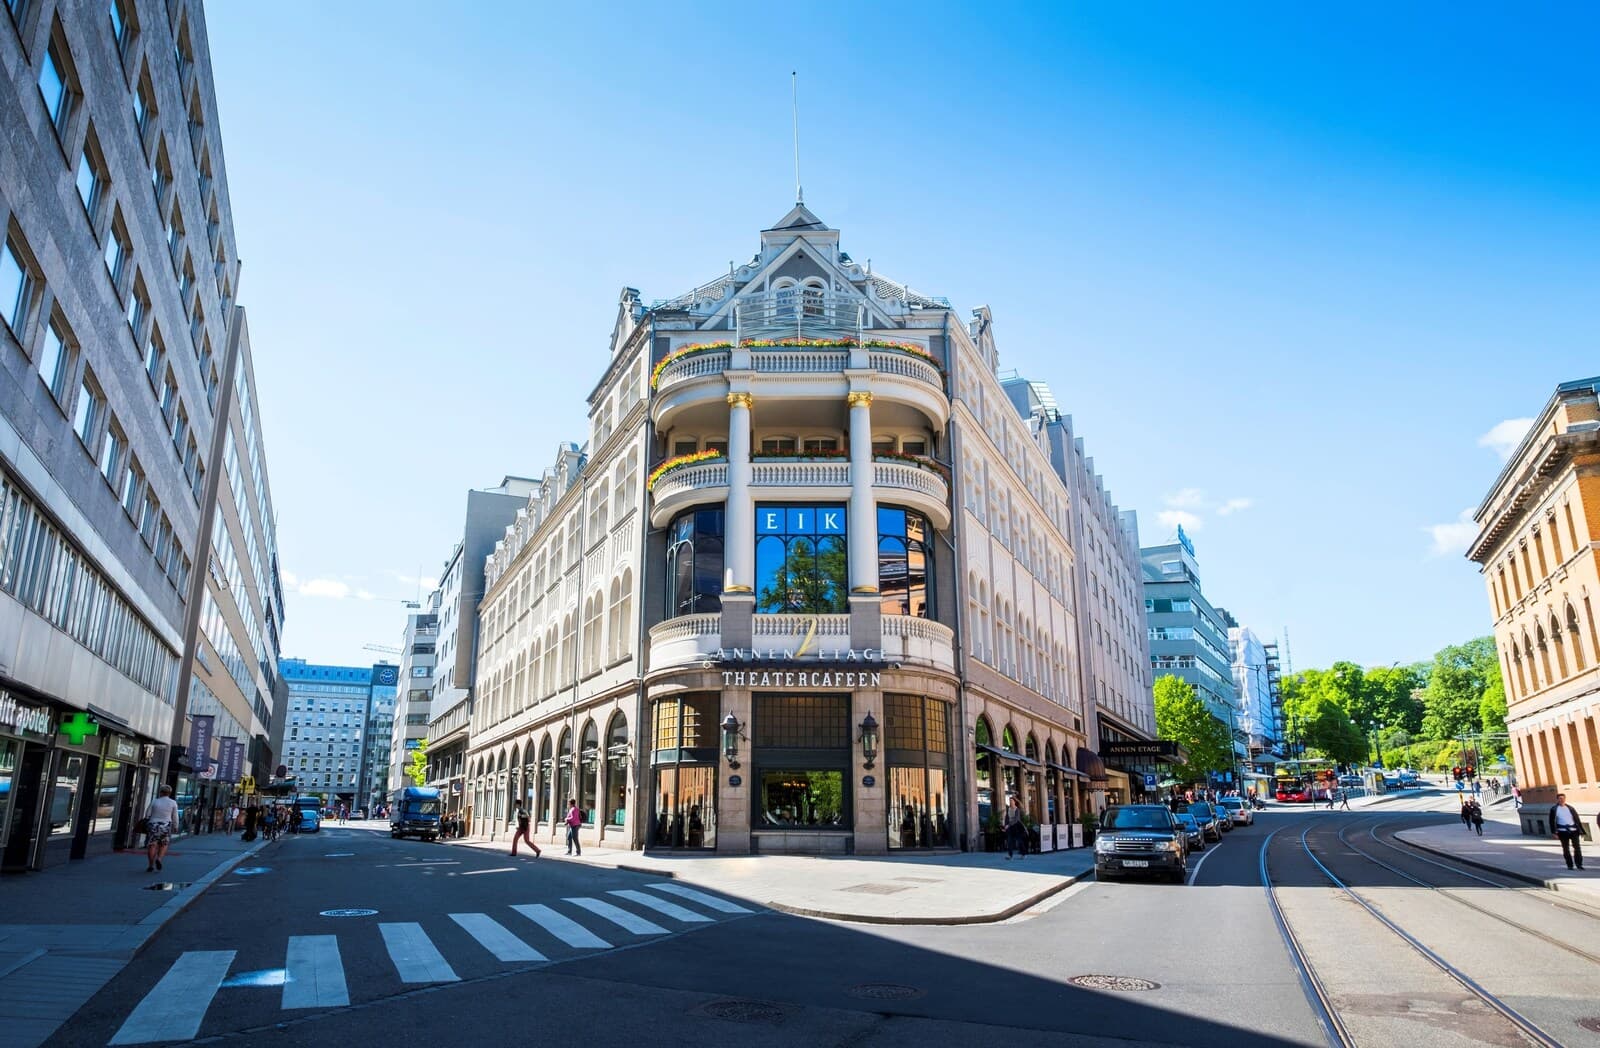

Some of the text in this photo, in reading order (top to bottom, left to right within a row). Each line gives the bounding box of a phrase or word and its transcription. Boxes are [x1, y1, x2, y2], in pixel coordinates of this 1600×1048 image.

[766, 513, 839, 530] EIK
[716, 648, 794, 660] ANNEN
[722, 671, 881, 687] THEATERCAFEEN
[15, 705, 50, 736] apotek
[1146, 775, 1153, 784] P
